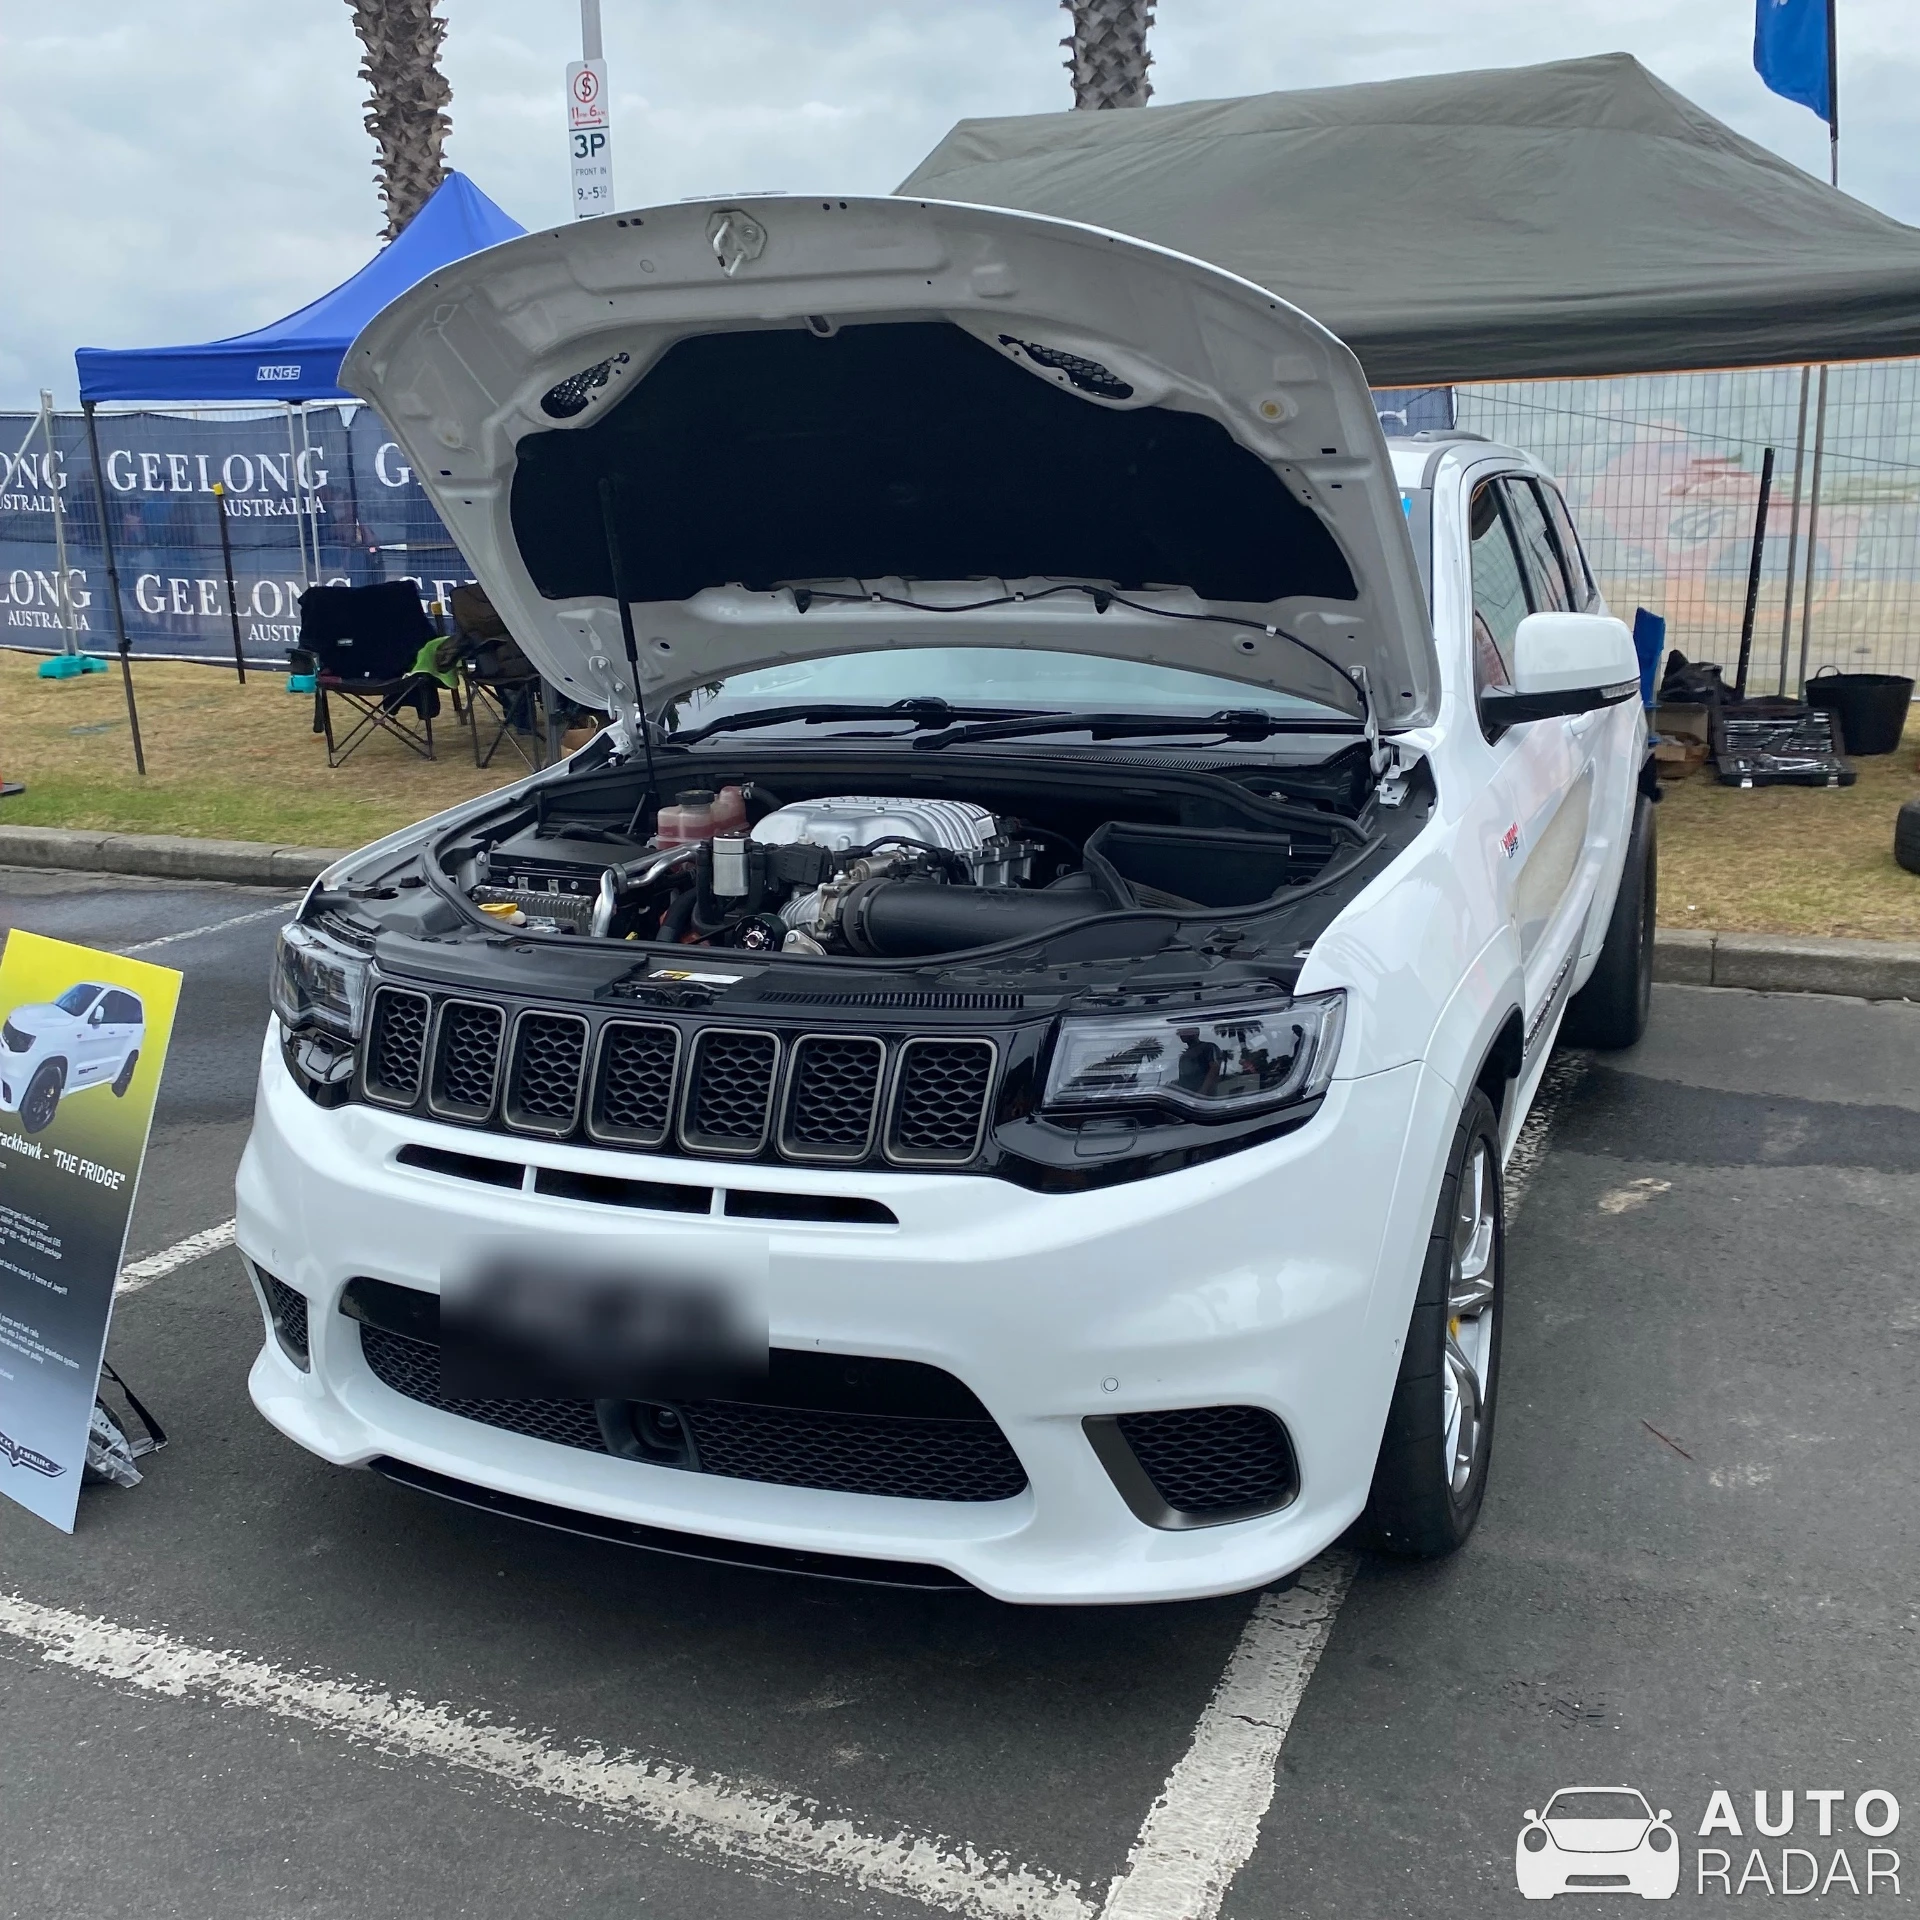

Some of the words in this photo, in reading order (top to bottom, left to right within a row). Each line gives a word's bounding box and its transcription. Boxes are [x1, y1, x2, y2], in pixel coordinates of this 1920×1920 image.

[574, 133, 606, 158] 3P
[575, 167, 597, 176] FRONT
[600, 166, 607, 175] IN
[257, 366, 301, 380] KINGS
[106, 447, 329, 493] GEELONG
[0, 1130, 42, 1160] rackhawk
